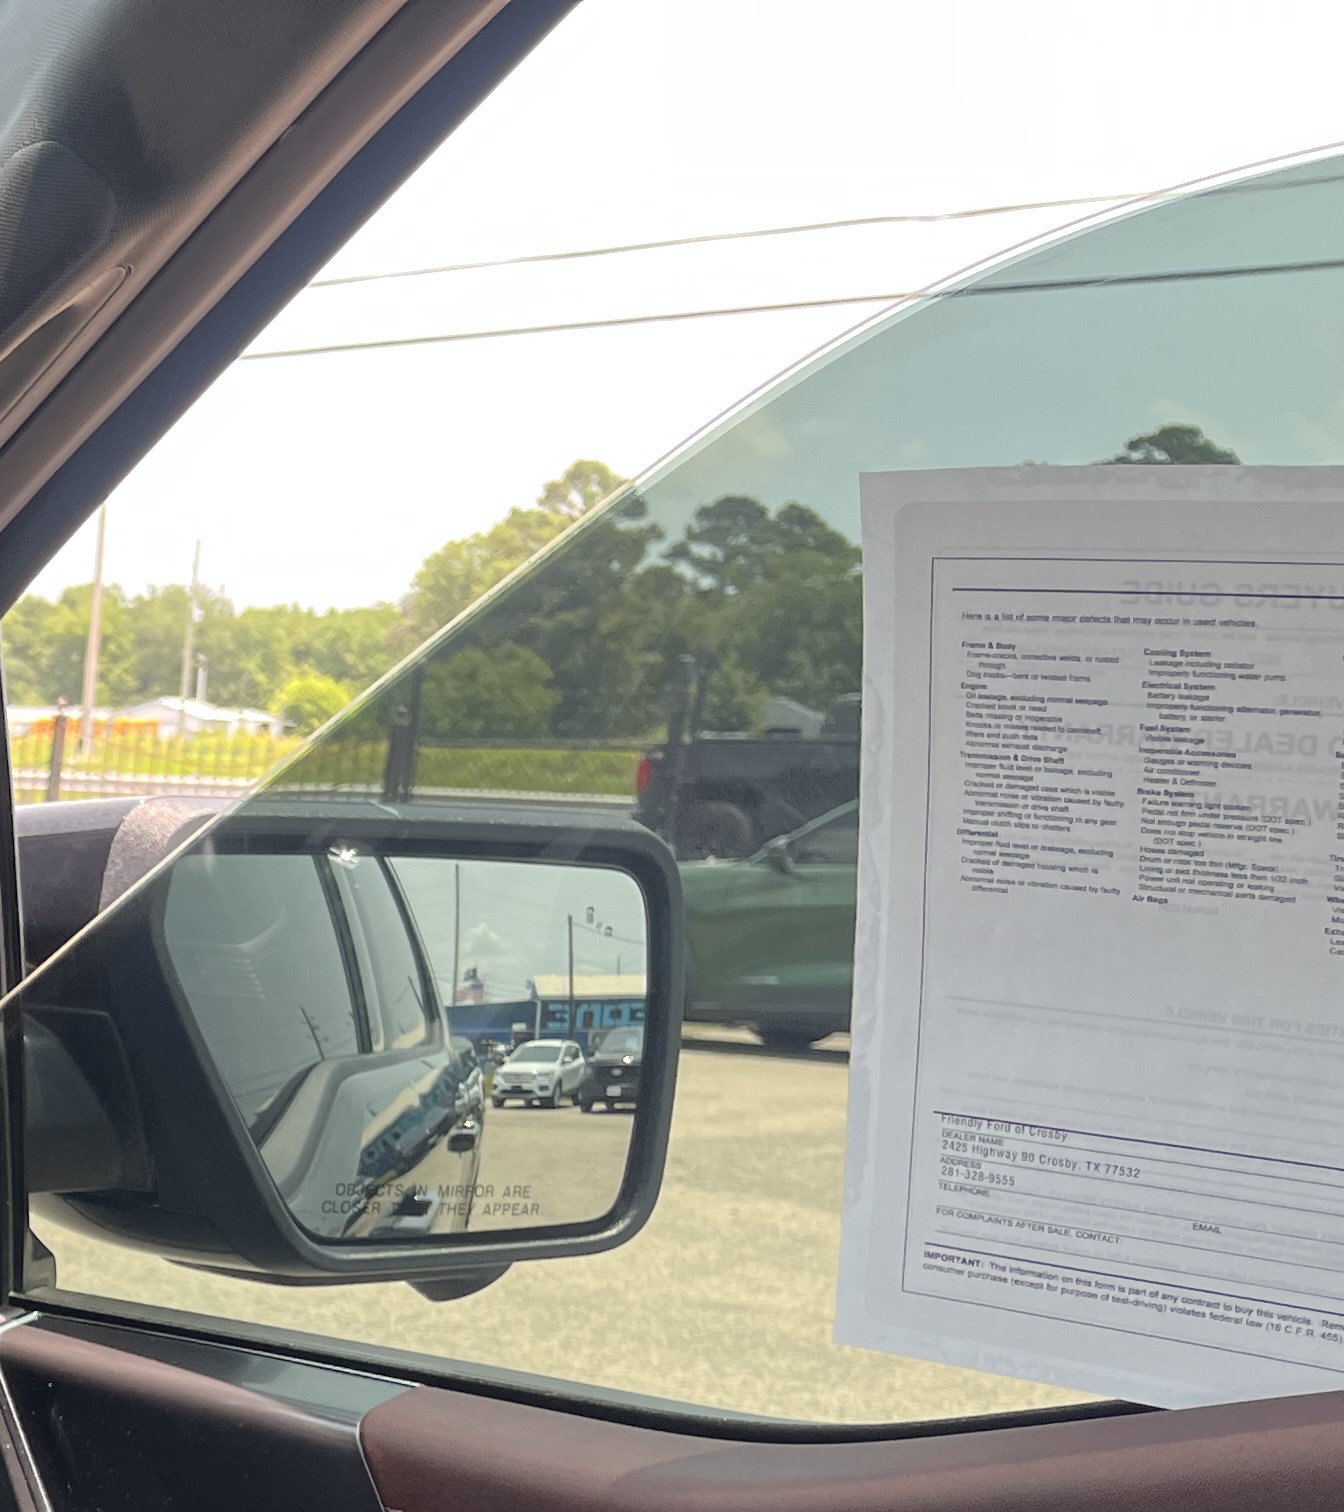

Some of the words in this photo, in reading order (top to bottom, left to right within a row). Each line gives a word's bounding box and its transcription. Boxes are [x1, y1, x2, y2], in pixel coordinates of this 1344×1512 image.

[941, 1114, 984, 1129] Friendly
[987, 1118, 1012, 1132] Ford
[1014, 1124, 1026, 1134] of
[1028, 1124, 1068, 1142] Crosby
[978, 1136, 1004, 1146] NAME
[942, 1140, 968, 1153] 2425
[972, 1145, 1017, 1161] Highway
[1020, 1151, 1035, 1163] 90
[1086, 1160, 1100, 1172] TX
[1104, 1163, 1141, 1179] 77532
[941, 1166, 1015, 1186] 281-328-9555
[438, 1185, 494, 1198] MIRROR
[503, 1185, 531, 1198] ARE
[439, 1202, 476, 1215] THEY
[483, 1202, 540, 1215] APPEAR
[935, 1206, 954, 1217] FOR
